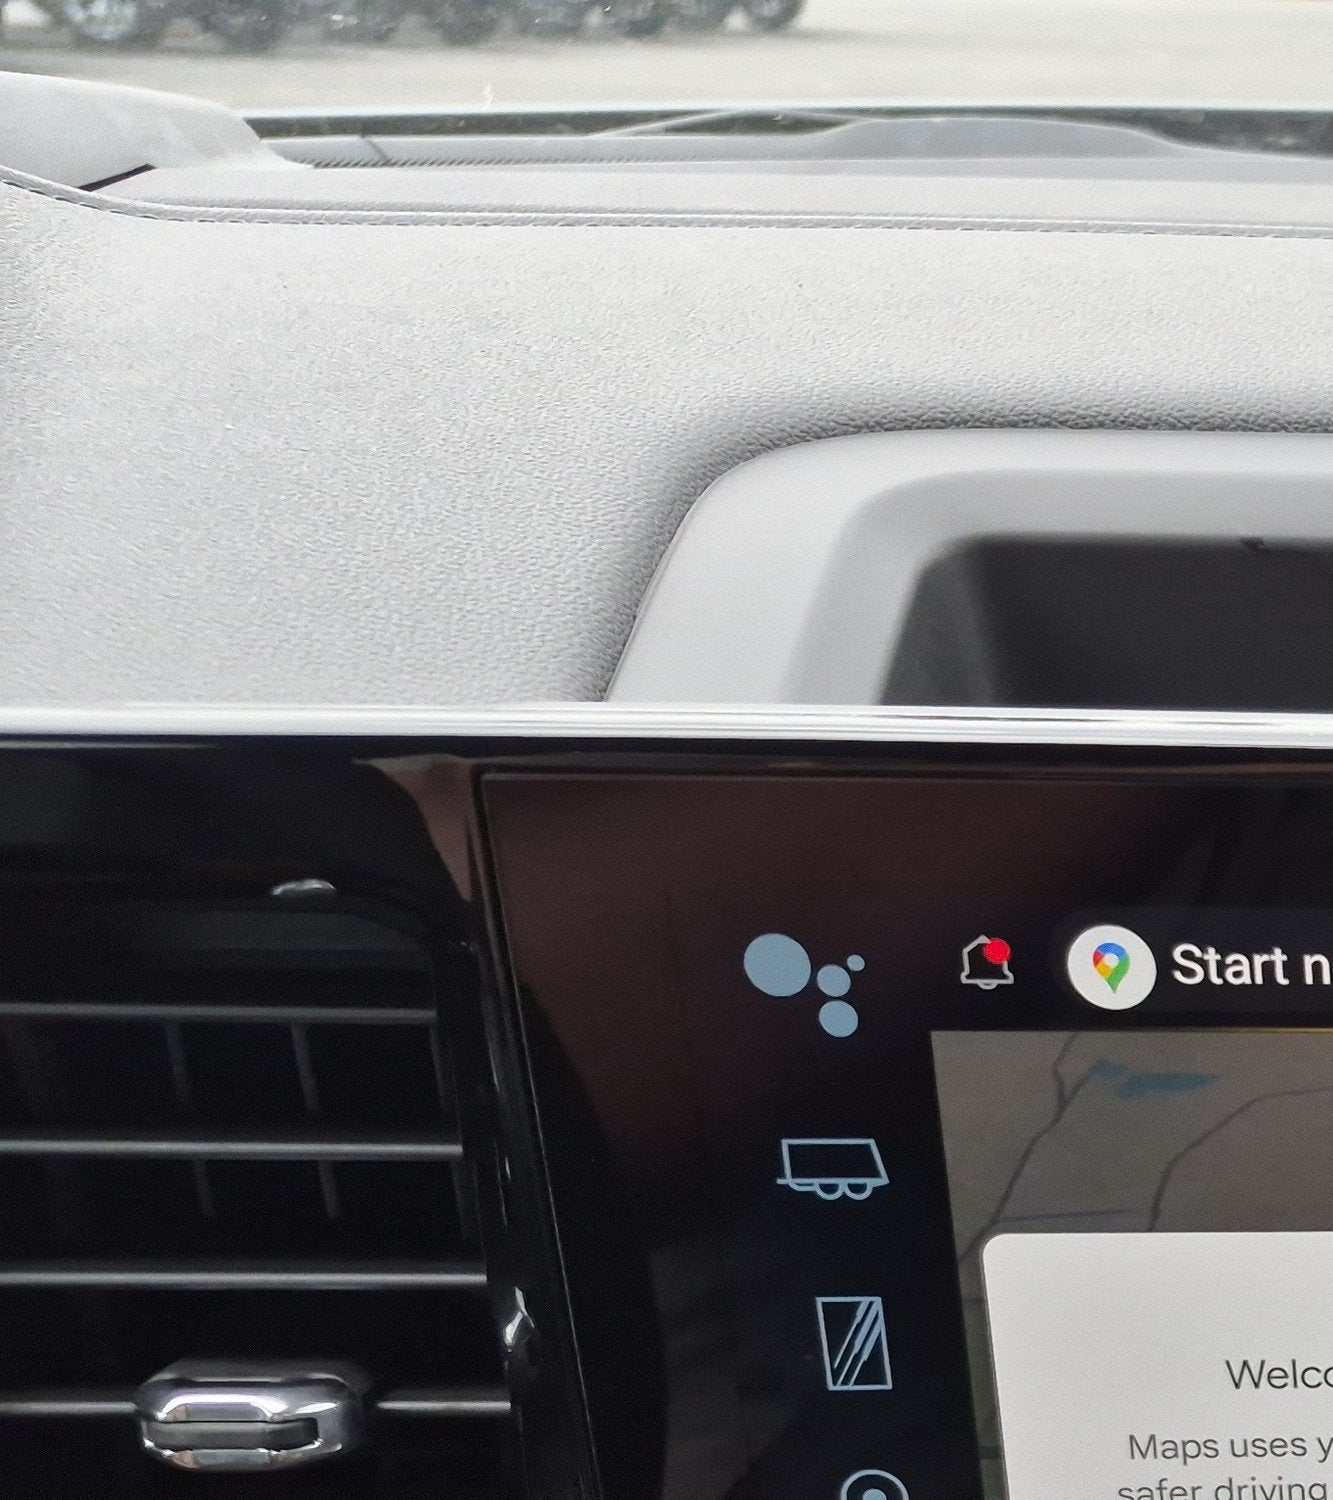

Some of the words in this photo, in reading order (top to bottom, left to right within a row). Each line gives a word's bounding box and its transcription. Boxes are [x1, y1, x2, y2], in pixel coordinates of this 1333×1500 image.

[1171, 943, 1290, 985] Start
[1128, 1433, 1220, 1467] Maps
[1229, 1437, 1308, 1458] uses
